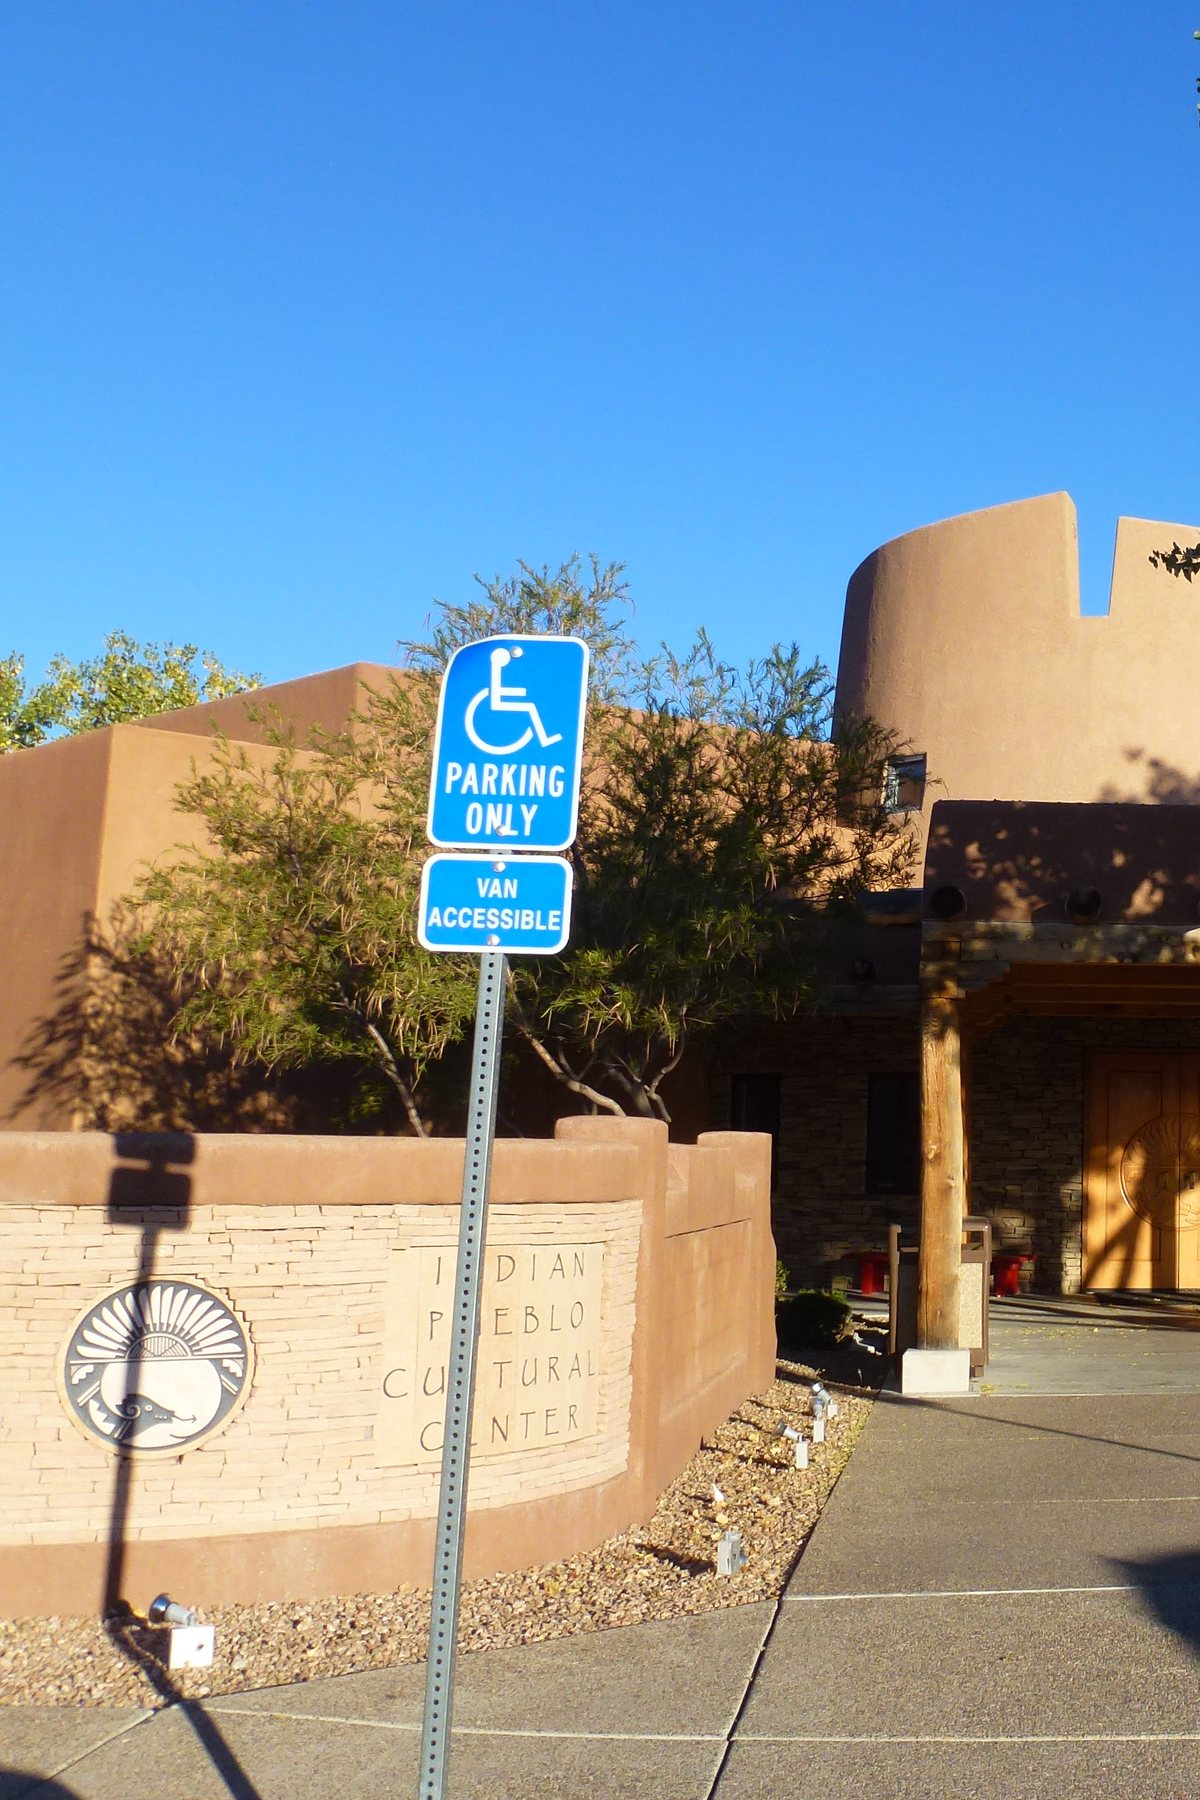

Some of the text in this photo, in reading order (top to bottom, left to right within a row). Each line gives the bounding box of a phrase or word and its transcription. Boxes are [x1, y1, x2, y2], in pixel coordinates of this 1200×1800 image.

[445, 762, 565, 797] PARKING
[466, 803, 538, 837] ONLY
[477, 877, 518, 899] VAN
[427, 907, 561, 931] ACCESSIBLE
[436, 1252, 585, 1285] IDIAN
[430, 1301, 584, 1340] PEBLO
[383, 1350, 595, 1398] CUTURAL
[420, 1404, 577, 1452] CNTER
